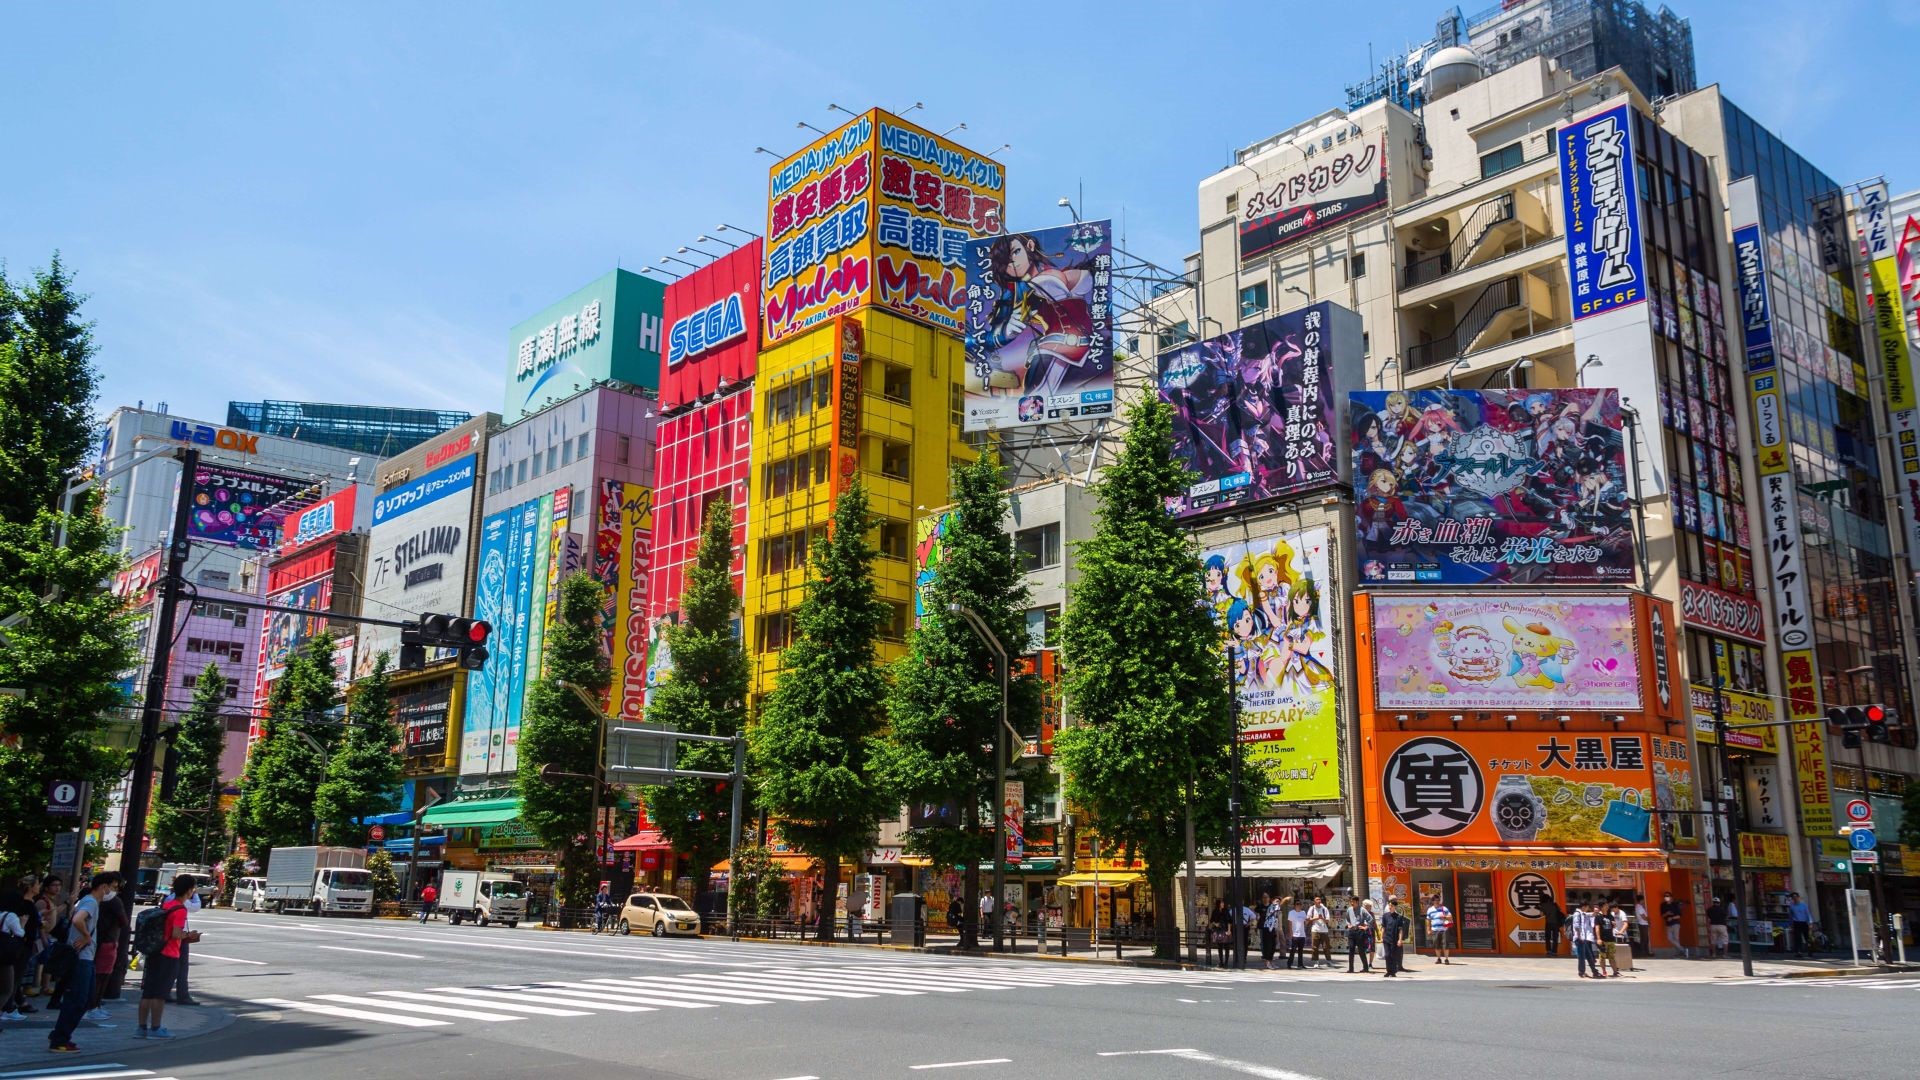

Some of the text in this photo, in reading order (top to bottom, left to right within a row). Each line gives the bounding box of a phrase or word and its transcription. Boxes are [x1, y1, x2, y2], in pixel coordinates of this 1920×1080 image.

[772, 116, 871, 198] MEDIAリサイクル
[880, 122, 1002, 190] MEDIAリサイクル
[771, 151, 870, 240] 激安販売
[881, 155, 1001, 234] 激安販売
[1246, 145, 1376, 219] メイドカジノ
[767, 198, 868, 288] 高額買取
[1278, 202, 1342, 235] POKER STARS
[1865, 191, 1888, 253] スーパービル
[976, 246, 995, 300] いつでも
[1574, 242, 1590, 297] 秋葉原店
[667, 291, 748, 367] SEGA
[775, 319, 804, 340] ムーラン
[805, 310, 827, 327] AKIBA
[890, 299, 929, 320] ムーラン
[929, 312, 957, 329] AKIBA
[1089, 254, 1111, 370] 準備は整ったぞ。
[843, 364, 858, 374] DVD
[1300, 311, 1321, 458] 我の射程内にのみ
[1757, 378, 1772, 390] 3F
[844, 392, 855, 401] CD
[1285, 405, 1302, 479] 真理あり
[386, 482, 426, 512] ソフマップ
[395, 525, 462, 576] STELLAMAP
[1390, 517, 1496, 545] 赤き血潮、
[1449, 537, 1603, 564] それは栄光を求む
[1682, 585, 1761, 636] メイドカジノ
[1488, 758, 1533, 771] チケット
[1536, 737, 1646, 771] 大黒屋
[1396, 751, 1474, 826] 質
[1757, 776, 1774, 825] ルノアール
[1813, 759, 1830, 804] FREE
[1852, 805, 1866, 816] 40
[873, 876, 882, 909] KIRIN
[1514, 880, 1549, 913] 質
